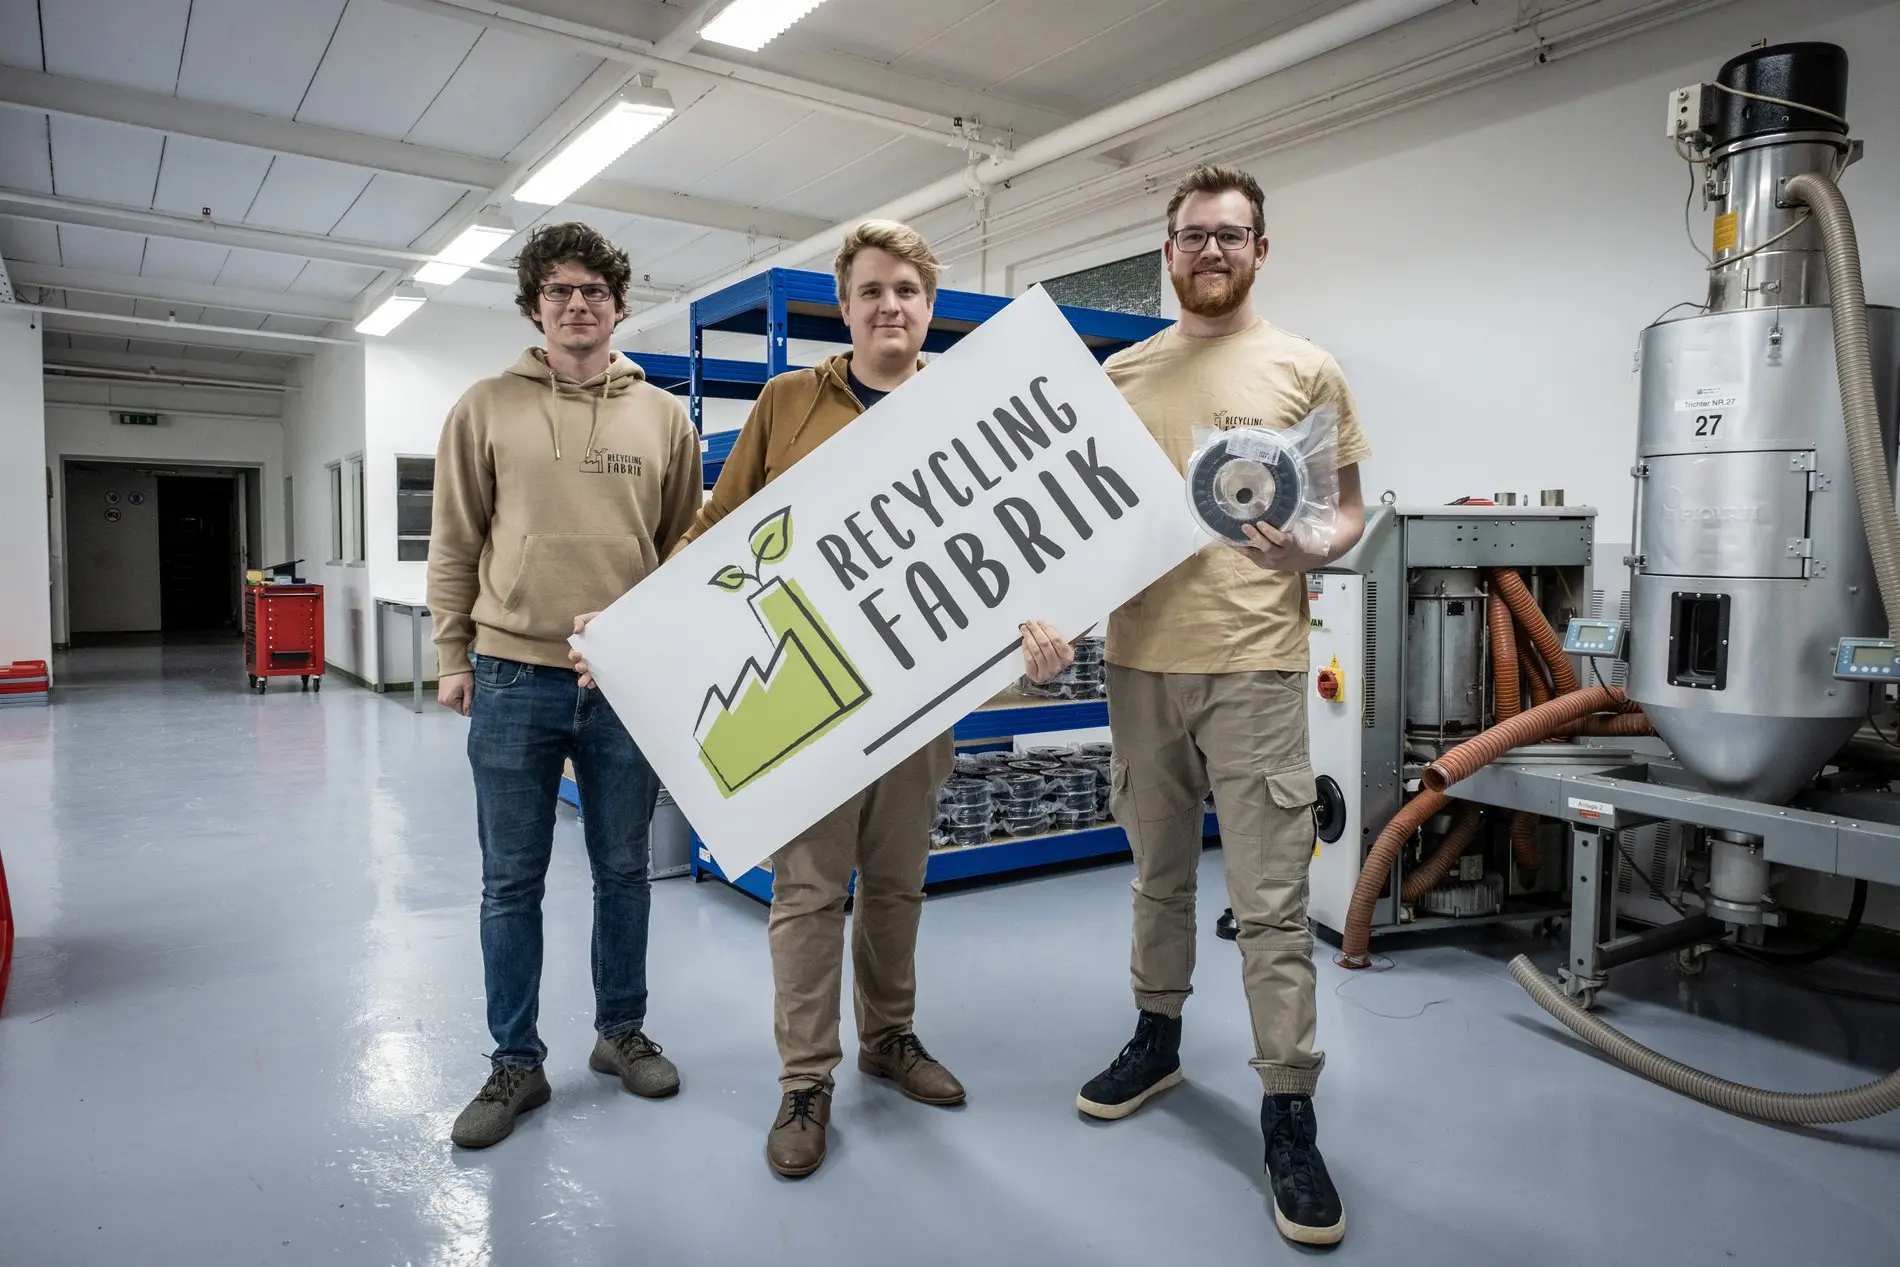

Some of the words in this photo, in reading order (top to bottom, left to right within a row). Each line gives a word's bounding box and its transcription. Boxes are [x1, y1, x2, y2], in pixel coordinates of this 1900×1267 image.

[1684, 401, 1711, 409] Trichter
[1695, 414, 1723, 437] 27
[607, 453, 642, 466] RECYCLING
[607, 462, 642, 477] FABRIK
[816, 376, 1078, 591] RECYCLING
[858, 436, 1140, 671] FABRIK
